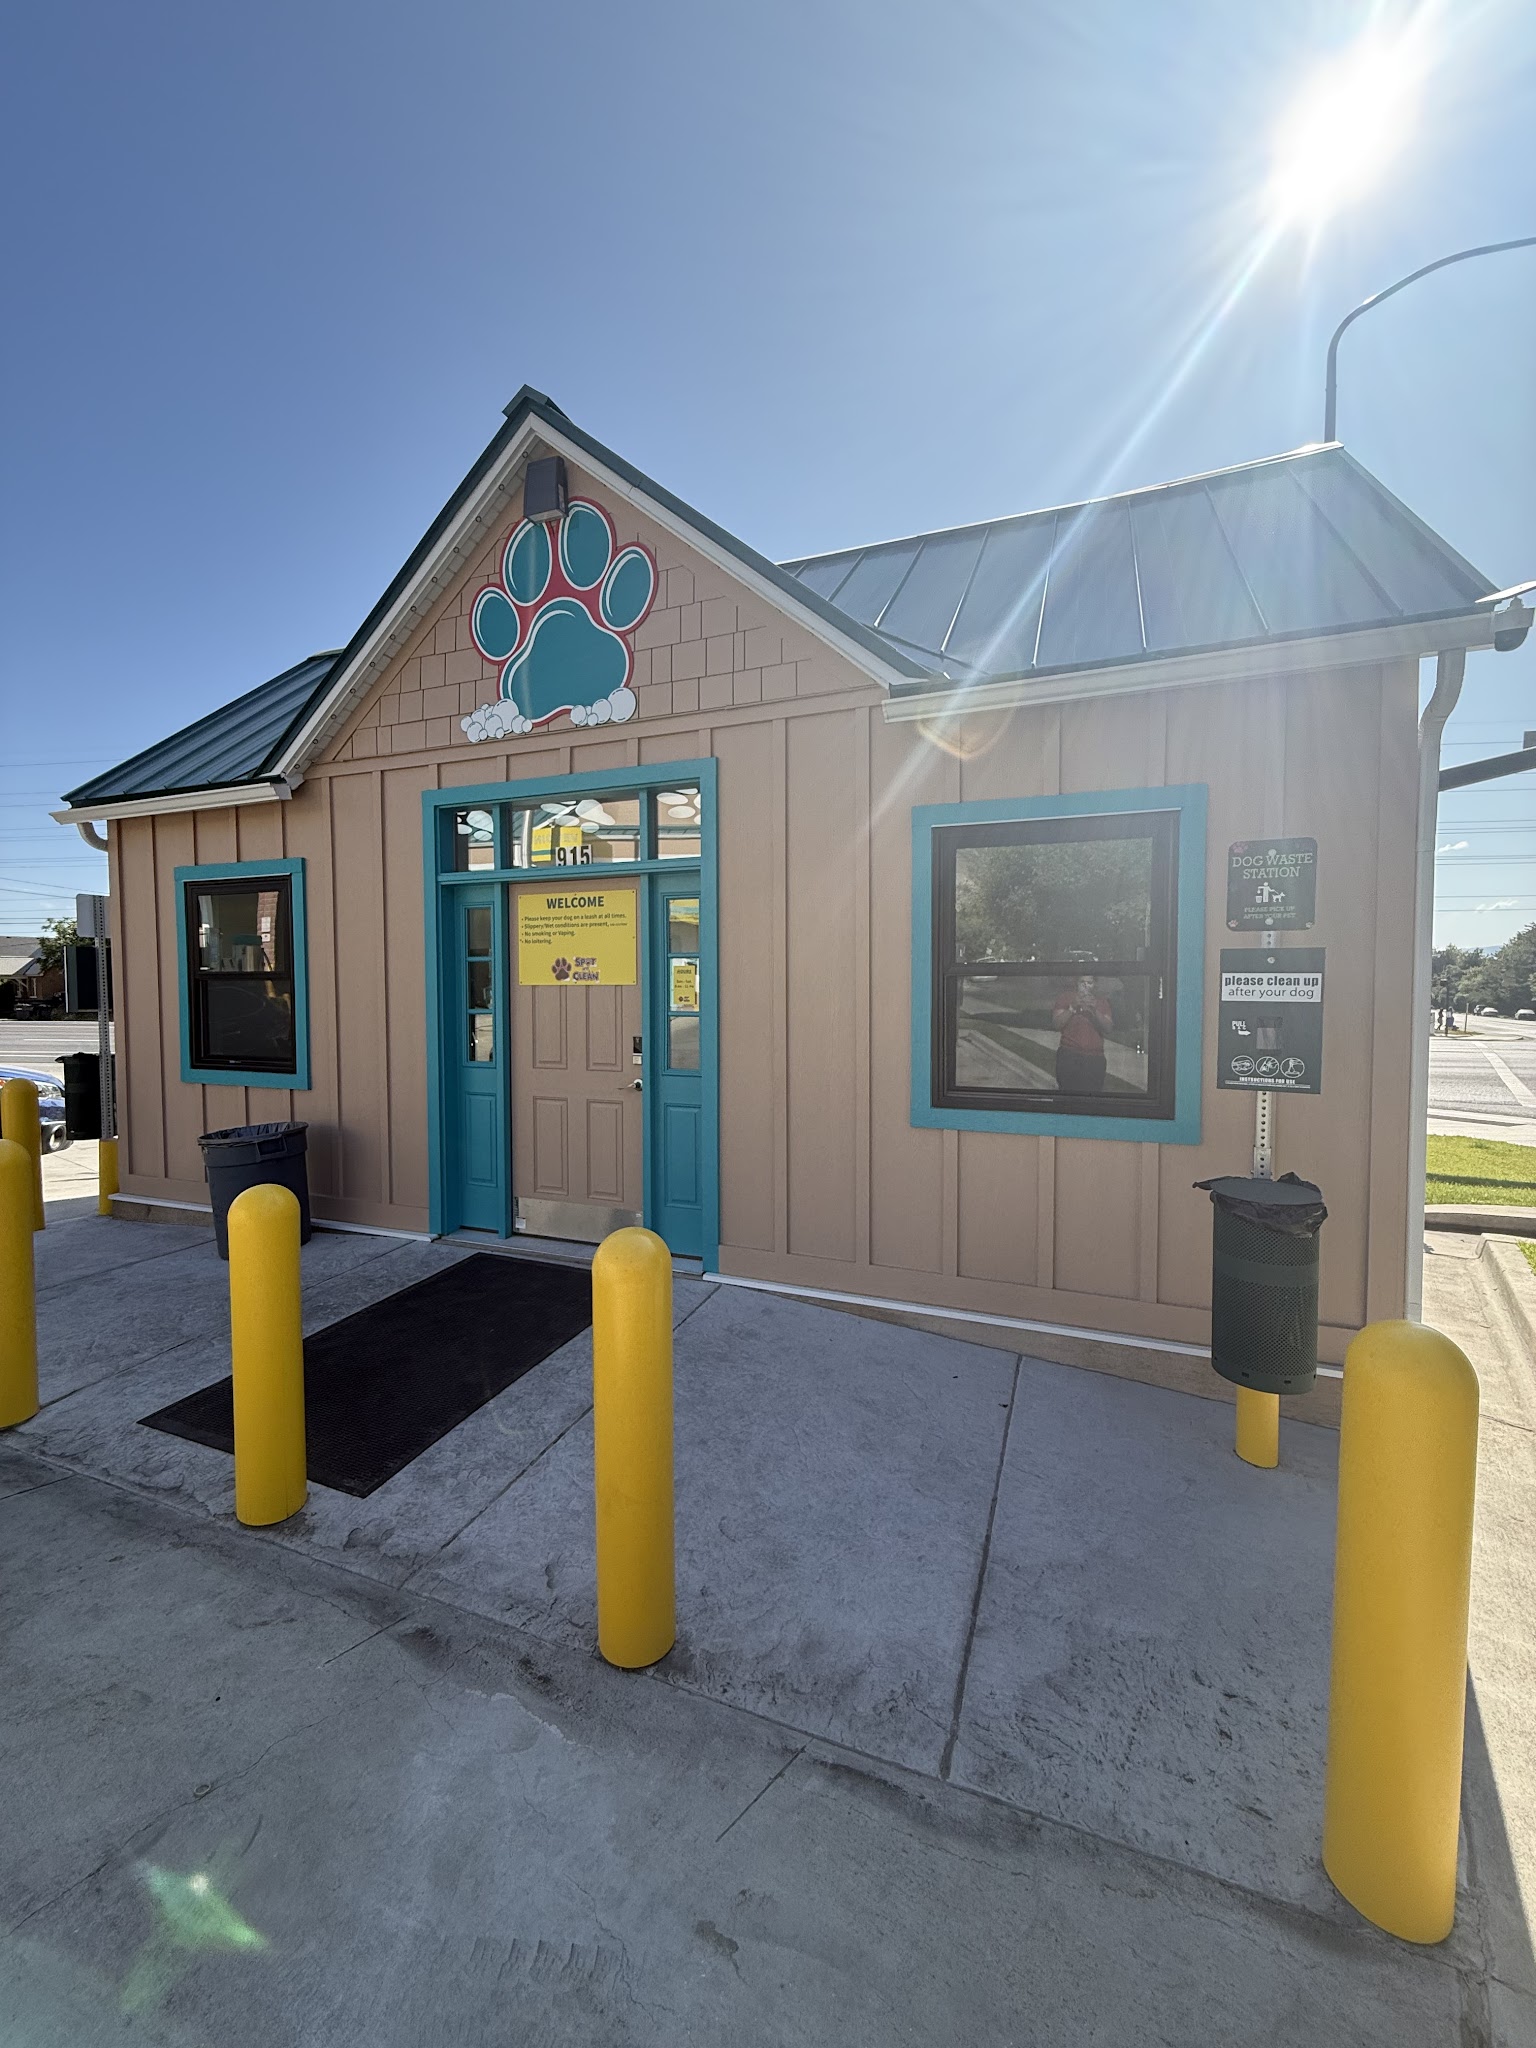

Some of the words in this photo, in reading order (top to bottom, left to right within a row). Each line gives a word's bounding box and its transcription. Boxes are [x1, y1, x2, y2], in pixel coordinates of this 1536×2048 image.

[557, 845, 590, 866] 915
[1231, 855, 1264, 867] DOG
[1265, 852, 1313, 866] WASTE
[1242, 866, 1301, 879] STATION
[546, 896, 605, 909] WELCOME
[524, 922, 555, 930] Slippery/Wet
[589, 921, 609, 929] present,
[572, 971, 599, 981] CLEAN
[1224, 976, 1264, 987] please
[1266, 976, 1300, 986] clean
[1303, 976, 1319, 987] up
[1228, 986, 1258, 997] after
[1259, 989, 1287, 999] your
[1289, 987, 1314, 1000] dog
[1239, 1076, 1275, 1084] INSTRUCTIONS
